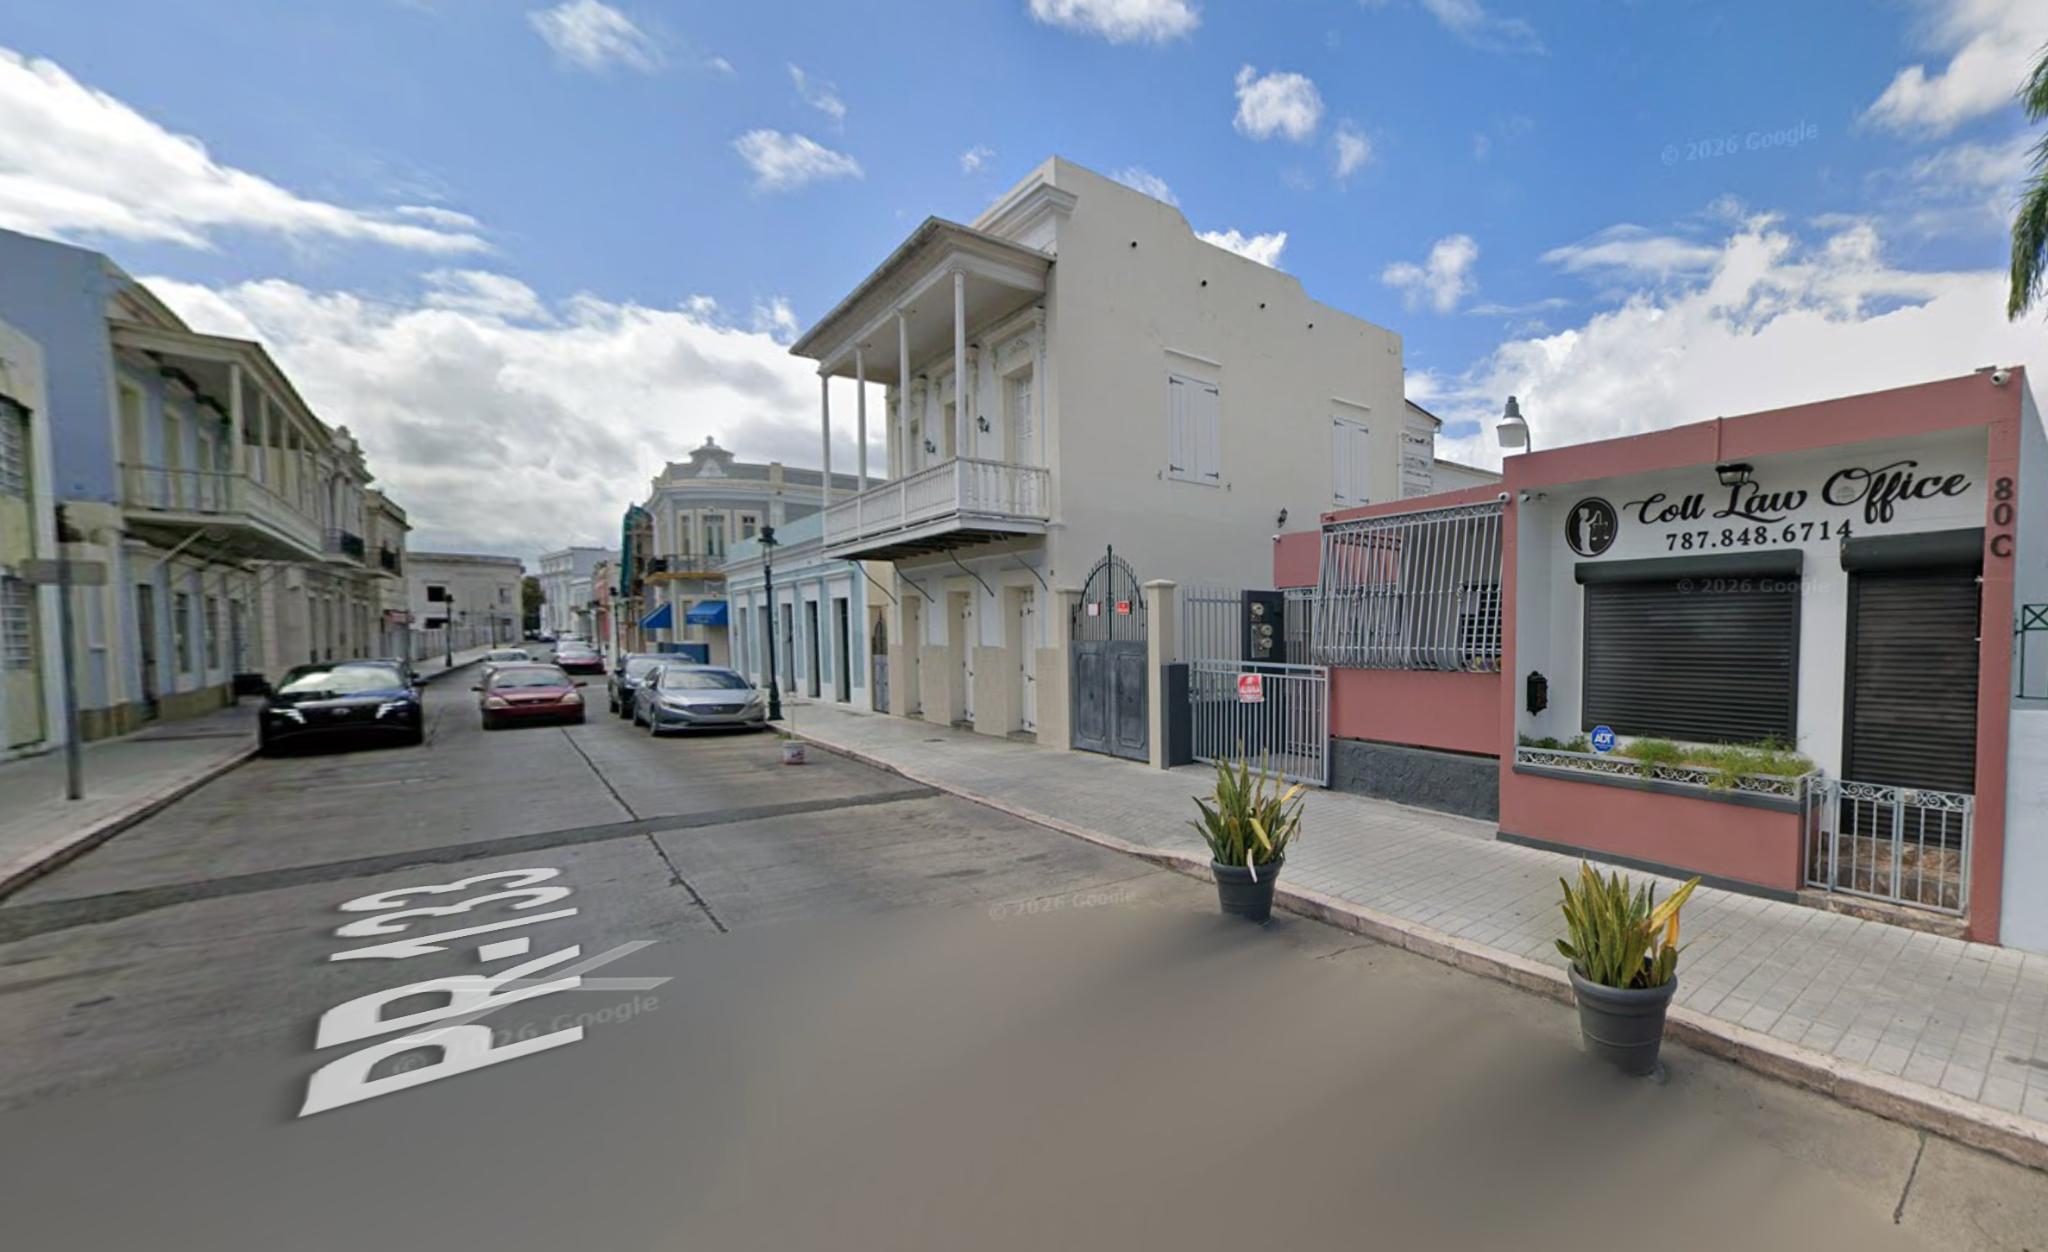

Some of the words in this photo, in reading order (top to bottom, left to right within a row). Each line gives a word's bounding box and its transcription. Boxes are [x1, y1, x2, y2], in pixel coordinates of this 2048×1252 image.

[1623, 493, 1706, 524] Coll
[1713, 480, 1808, 523] Law
[1822, 460, 1972, 524] Office
[1666, 518, 1853, 551] 787.848.6714
[1594, 733, 1612, 744] ADT
